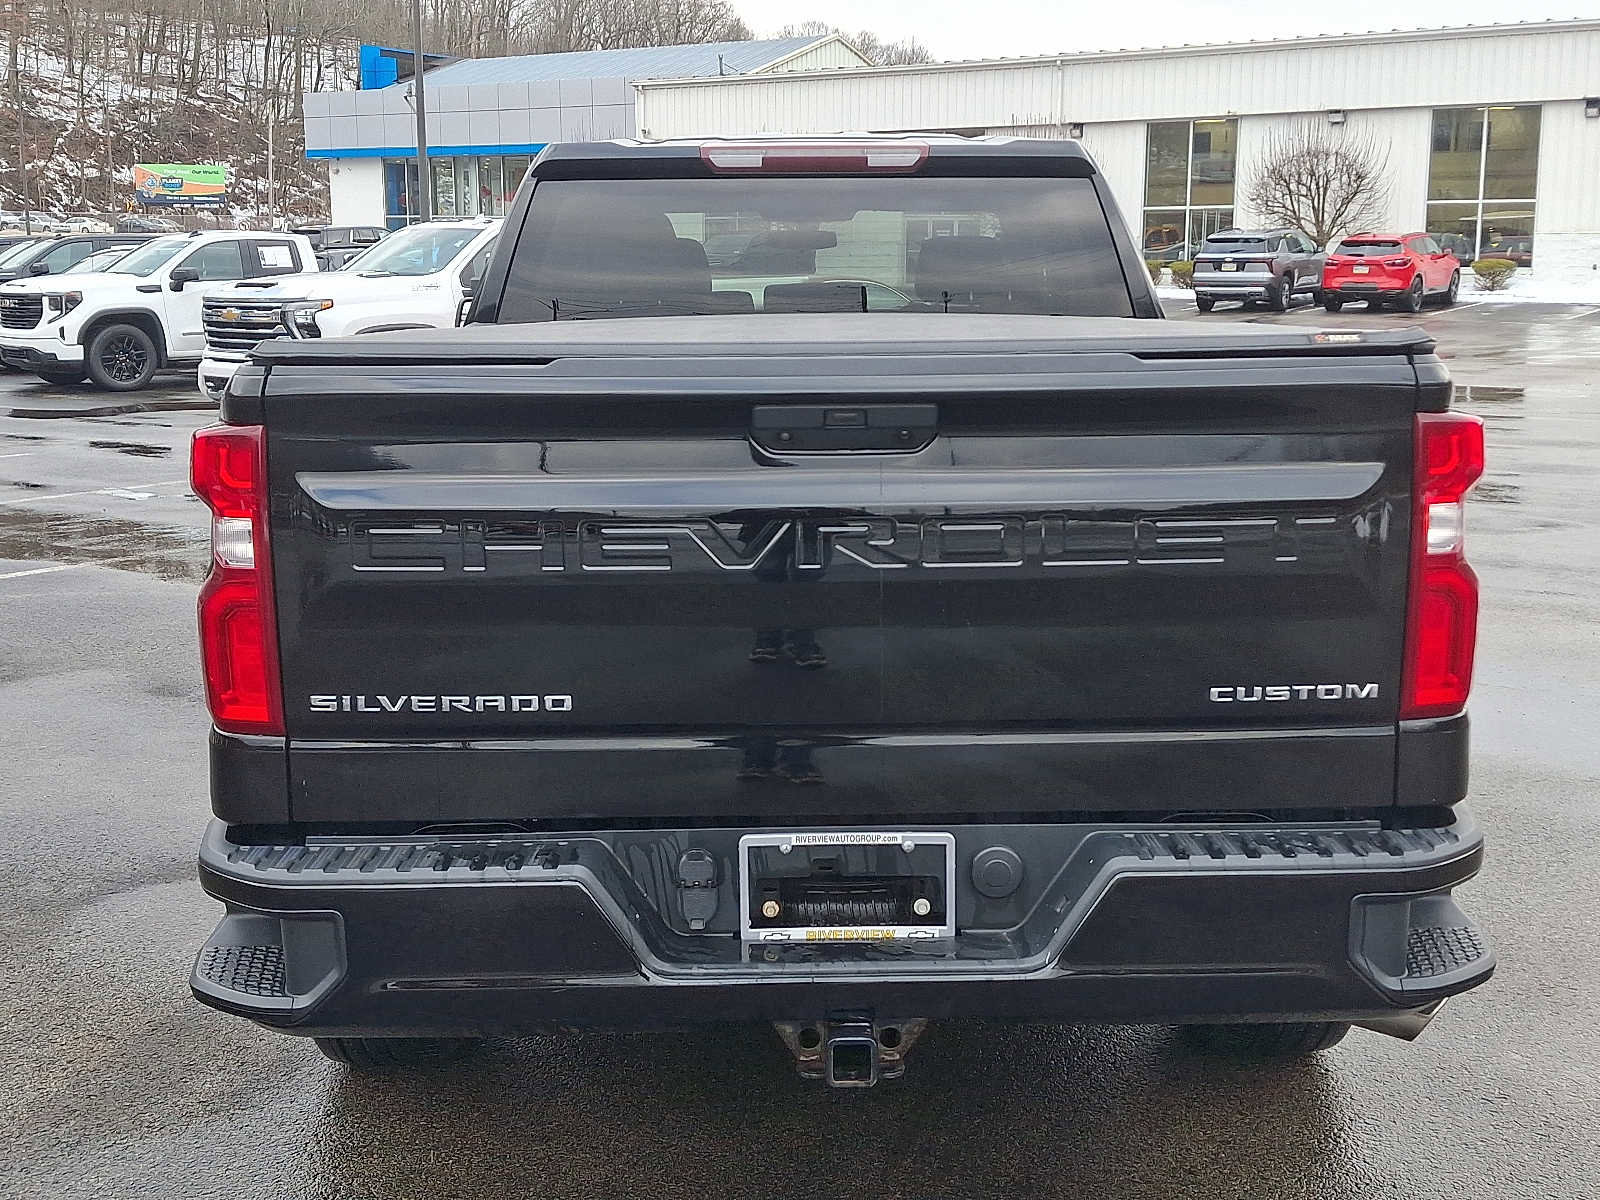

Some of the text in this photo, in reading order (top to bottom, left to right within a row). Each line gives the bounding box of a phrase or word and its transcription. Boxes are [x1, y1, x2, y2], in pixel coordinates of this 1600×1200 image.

[350, 515, 1338, 572] CHEVROLET
[1209, 683, 1379, 702] CUSTOM
[309, 694, 573, 713] SILVERADO
[795, 835, 899, 844] RIVERVIEWAUTOGROUP.com
[806, 929, 897, 941] RIVERVIEW
